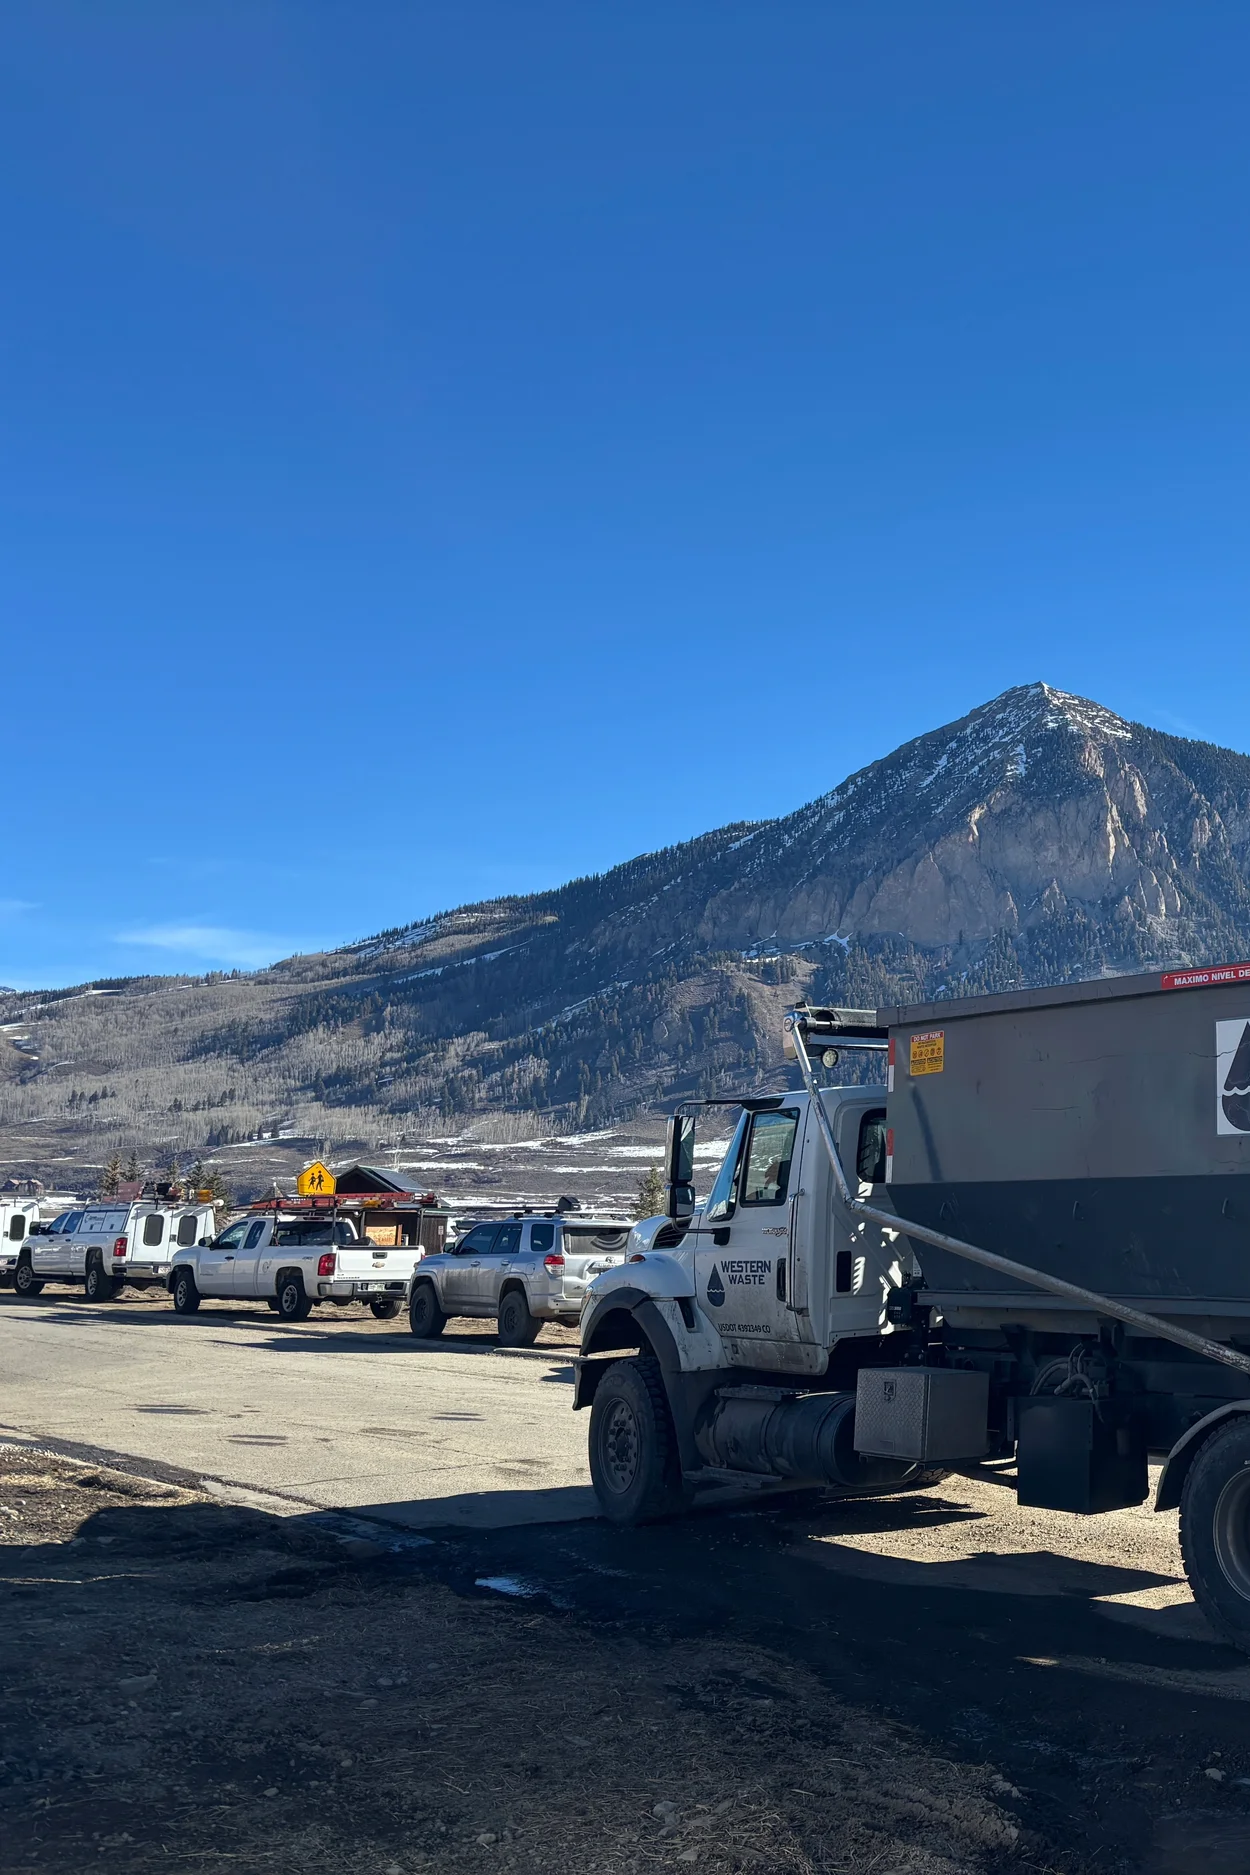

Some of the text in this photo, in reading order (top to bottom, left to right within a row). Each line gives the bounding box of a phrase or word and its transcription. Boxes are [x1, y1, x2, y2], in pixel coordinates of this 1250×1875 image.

[1174, 974, 1209, 985] MAXIMO
[1211, 971, 1236, 980] NIVEL
[1238, 969, 1250, 978] DE
[720, 1260, 771, 1273] WESTERN
[728, 1274, 765, 1285] WASTE
[717, 1322, 737, 1332] USDOT
[762, 1324, 771, 1333] CO
